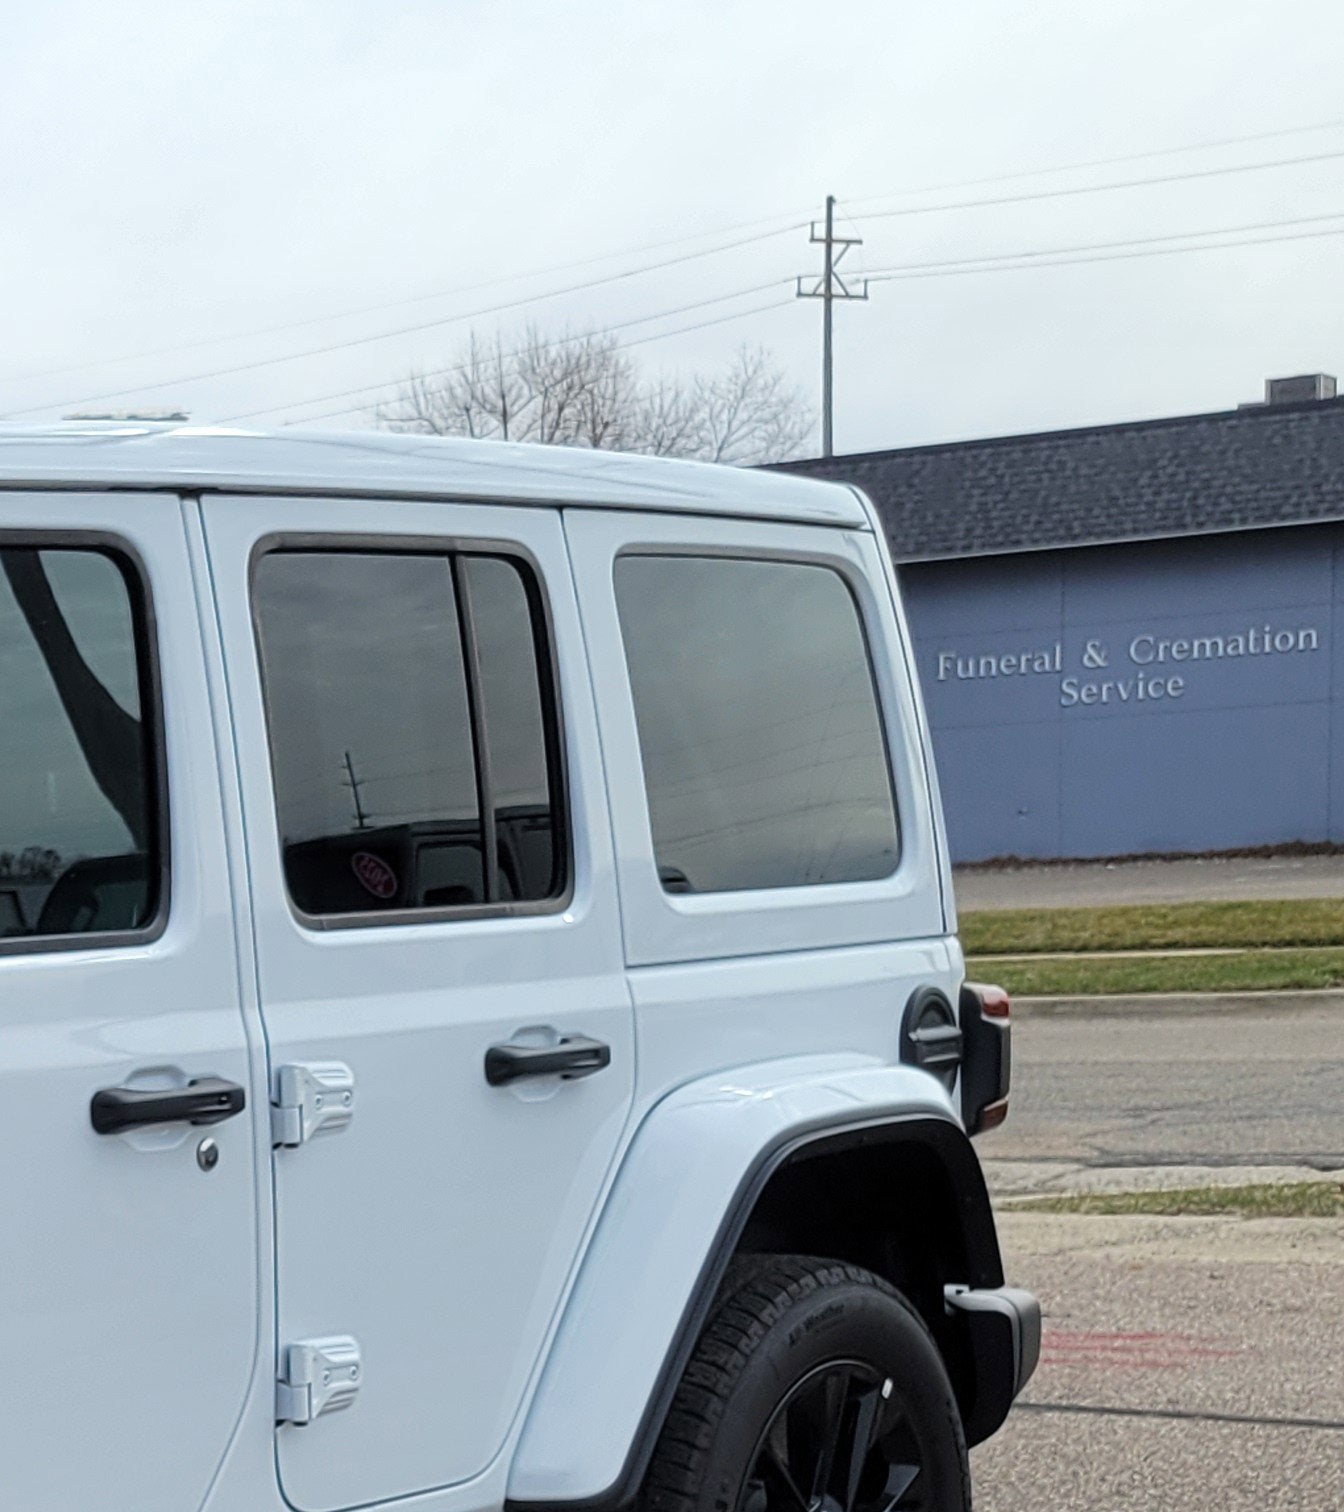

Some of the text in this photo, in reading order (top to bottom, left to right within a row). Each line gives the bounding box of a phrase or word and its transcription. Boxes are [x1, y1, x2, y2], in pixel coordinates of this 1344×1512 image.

[937, 625, 1319, 682] Funeral & Cremation
[1059, 672, 1186, 707] Service
